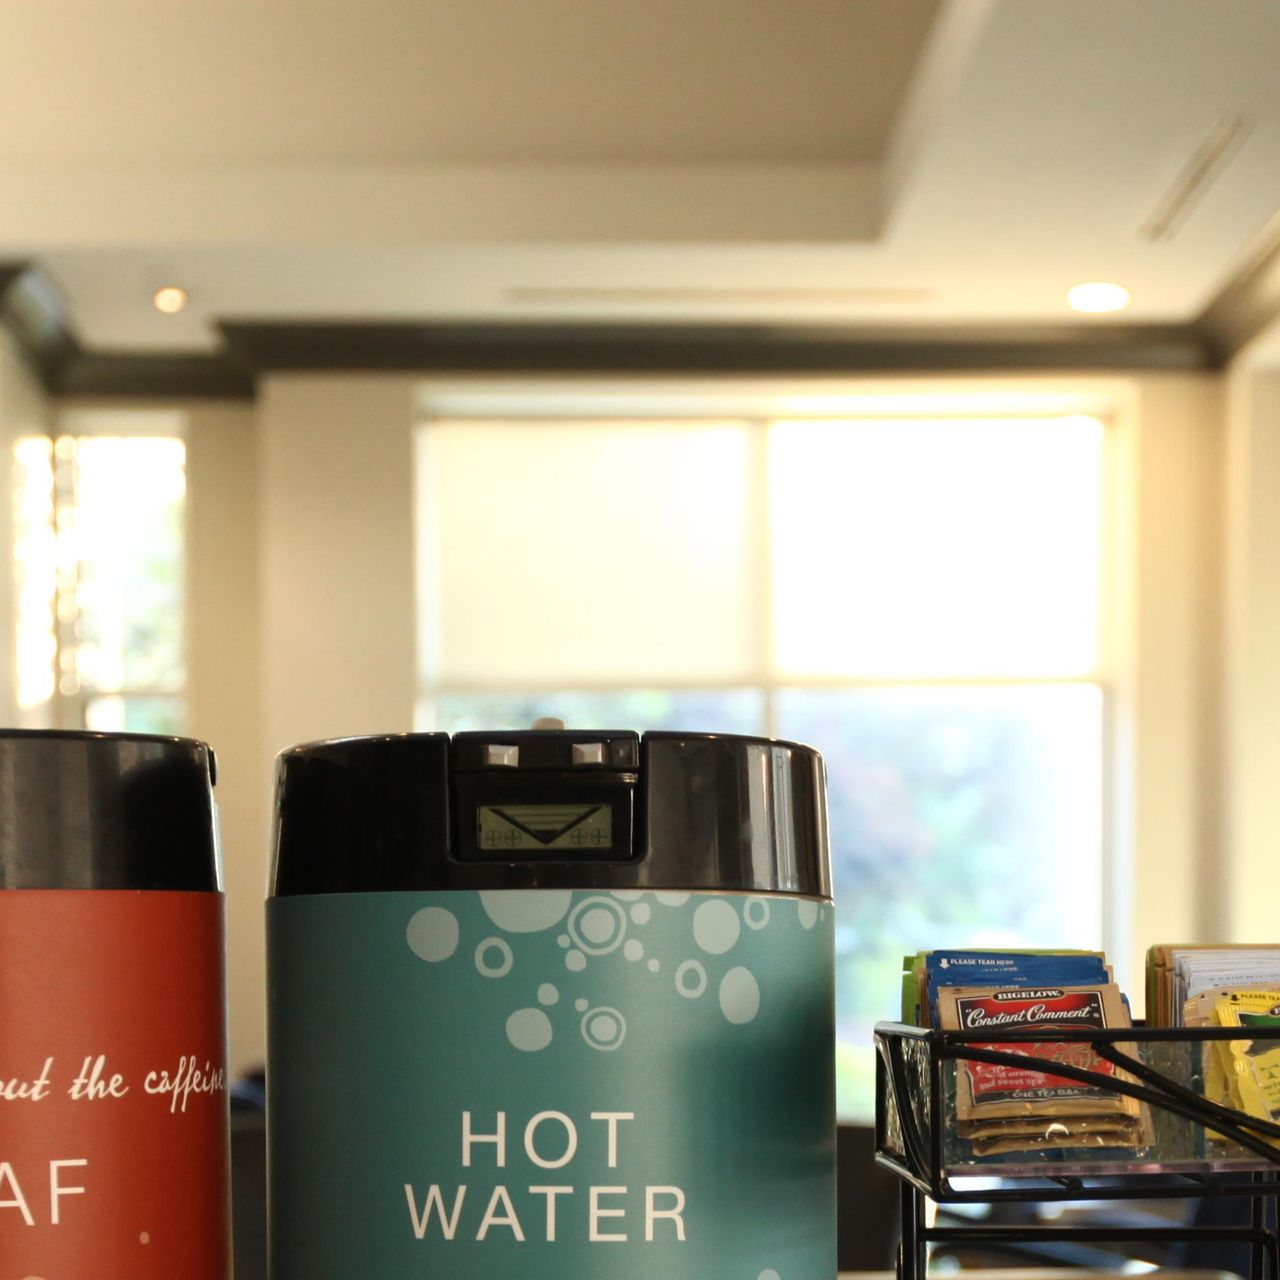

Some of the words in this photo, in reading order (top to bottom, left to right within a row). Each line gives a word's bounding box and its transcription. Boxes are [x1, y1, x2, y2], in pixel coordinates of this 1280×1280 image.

[997, 990, 1061, 1000] BIGELOW
[68, 1055, 130, 1102] the
[461, 1110, 635, 1169] HOT
[404, 1183, 687, 1242] WATER
